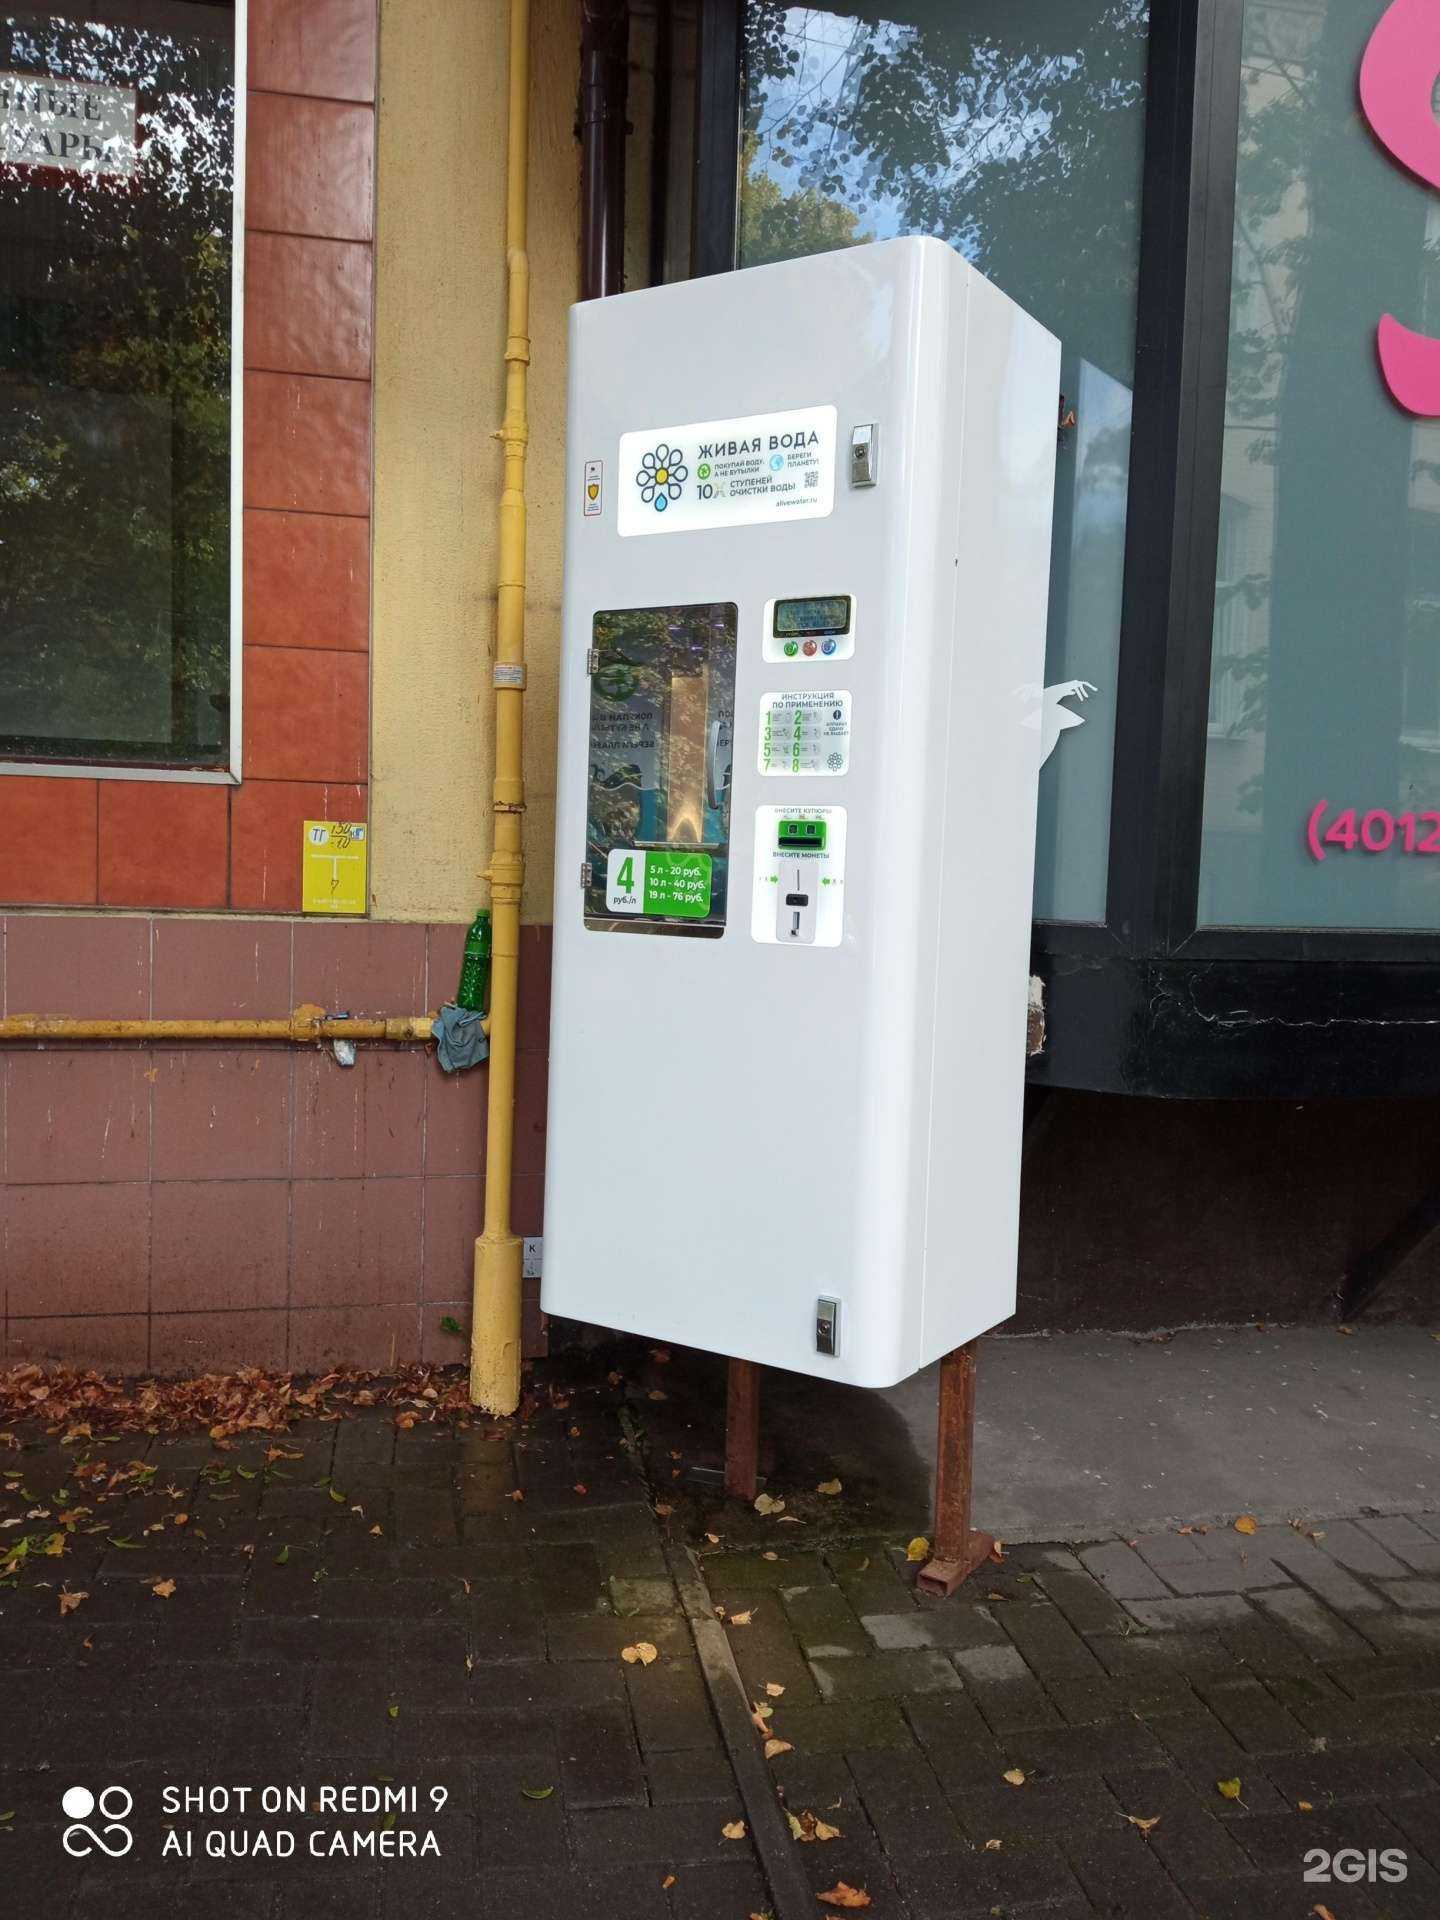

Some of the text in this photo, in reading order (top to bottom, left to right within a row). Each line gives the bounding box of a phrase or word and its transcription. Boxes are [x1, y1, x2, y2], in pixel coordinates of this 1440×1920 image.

[697, 430, 820, 460] ЖИВАЯ ВОДА
[720, 469, 729, 477] НЕ
[729, 466, 760, 476] БУТЫЛКИ
[730, 475, 773, 488] СТУПЕНЕЙ
[729, 482, 796, 497] ОЧИСТКИ ВОДЫ
[781, 692, 834, 700] ИНСТРУКЦИЯ
[772, 700, 843, 709] ПО ПРИМЕНЕНИЮ
[794, 710, 802, 725] 2
[764, 726, 771, 741] 3
[793, 726, 802, 741] 4
[763, 742, 800, 757] 5 6
[763, 759, 771, 772] 7
[792, 758, 800, 772] 8
[1308, 799, 1440, 861] (4012
[616, 856, 635, 894] 4
[650, 865, 656, 874] 5
[670, 866, 681, 875] 20
[683, 866, 702, 879] руб.
[650, 877, 659, 887] 10
[659, 879, 667, 887] л
[673, 879, 686, 888] 40
[687, 879, 706, 891] руб.
[650, 890, 658, 900] 19
[672, 891, 684, 901] 76
[685, 891, 704, 904] руб.
